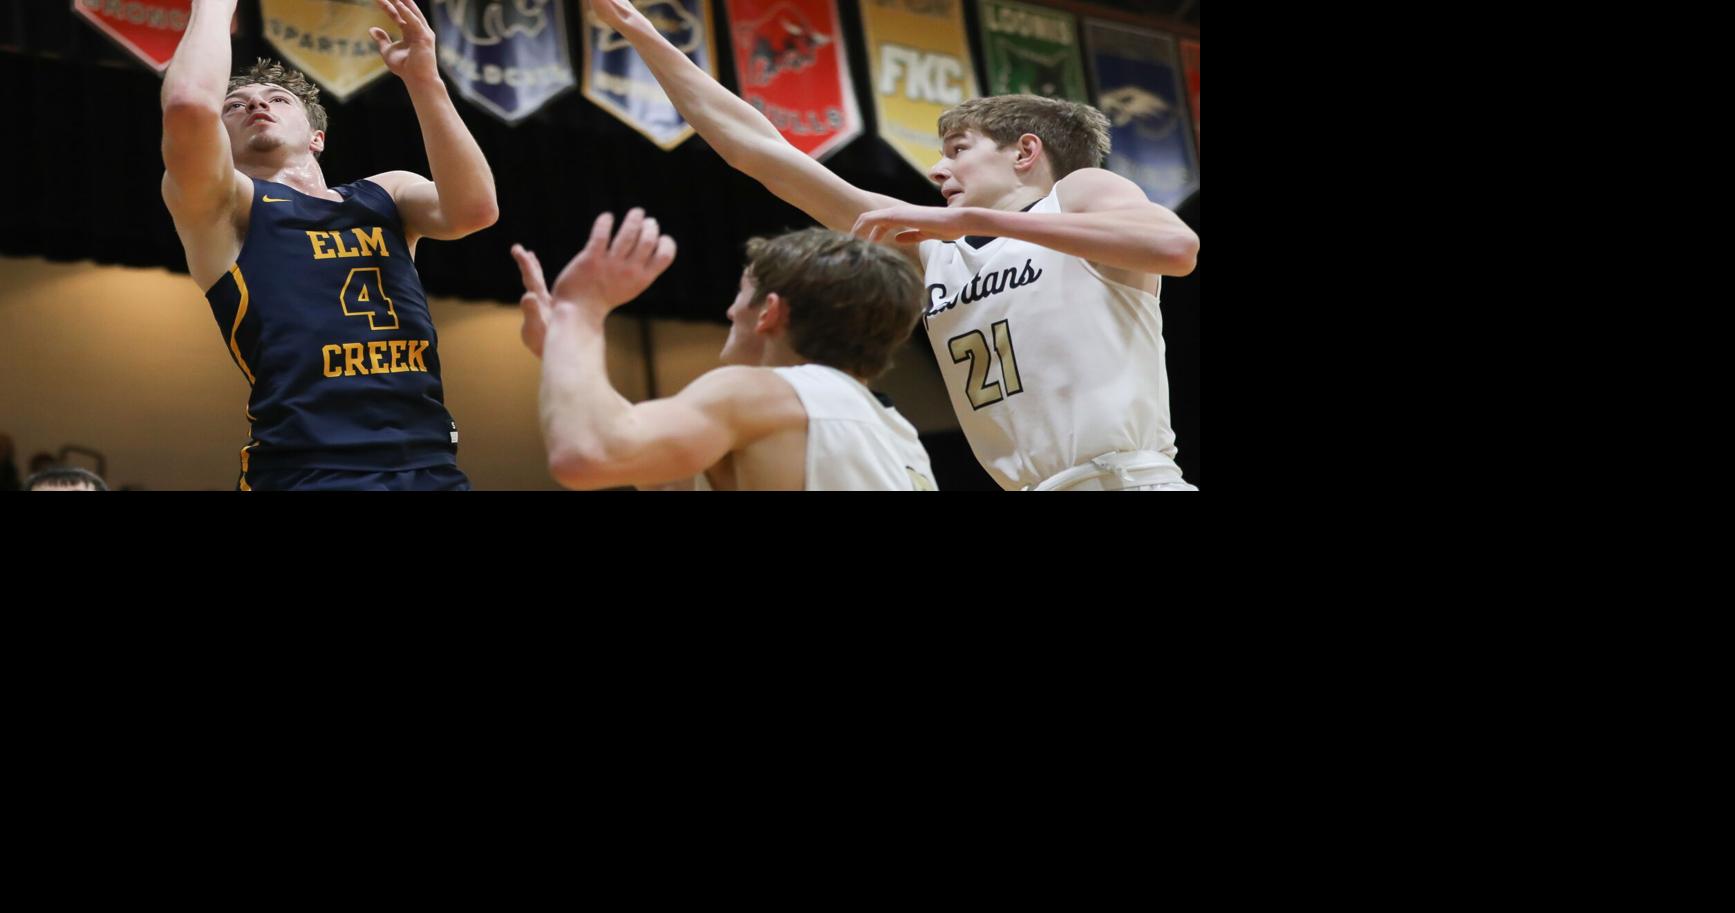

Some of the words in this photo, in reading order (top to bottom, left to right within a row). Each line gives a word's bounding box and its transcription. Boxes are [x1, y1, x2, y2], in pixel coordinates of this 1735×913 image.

[879, 43, 963, 105] FKC
[305, 227, 390, 260] ELM
[339, 267, 399, 331] 4
[321, 340, 429, 378] CREEK
[947, 318, 1024, 411] 21
